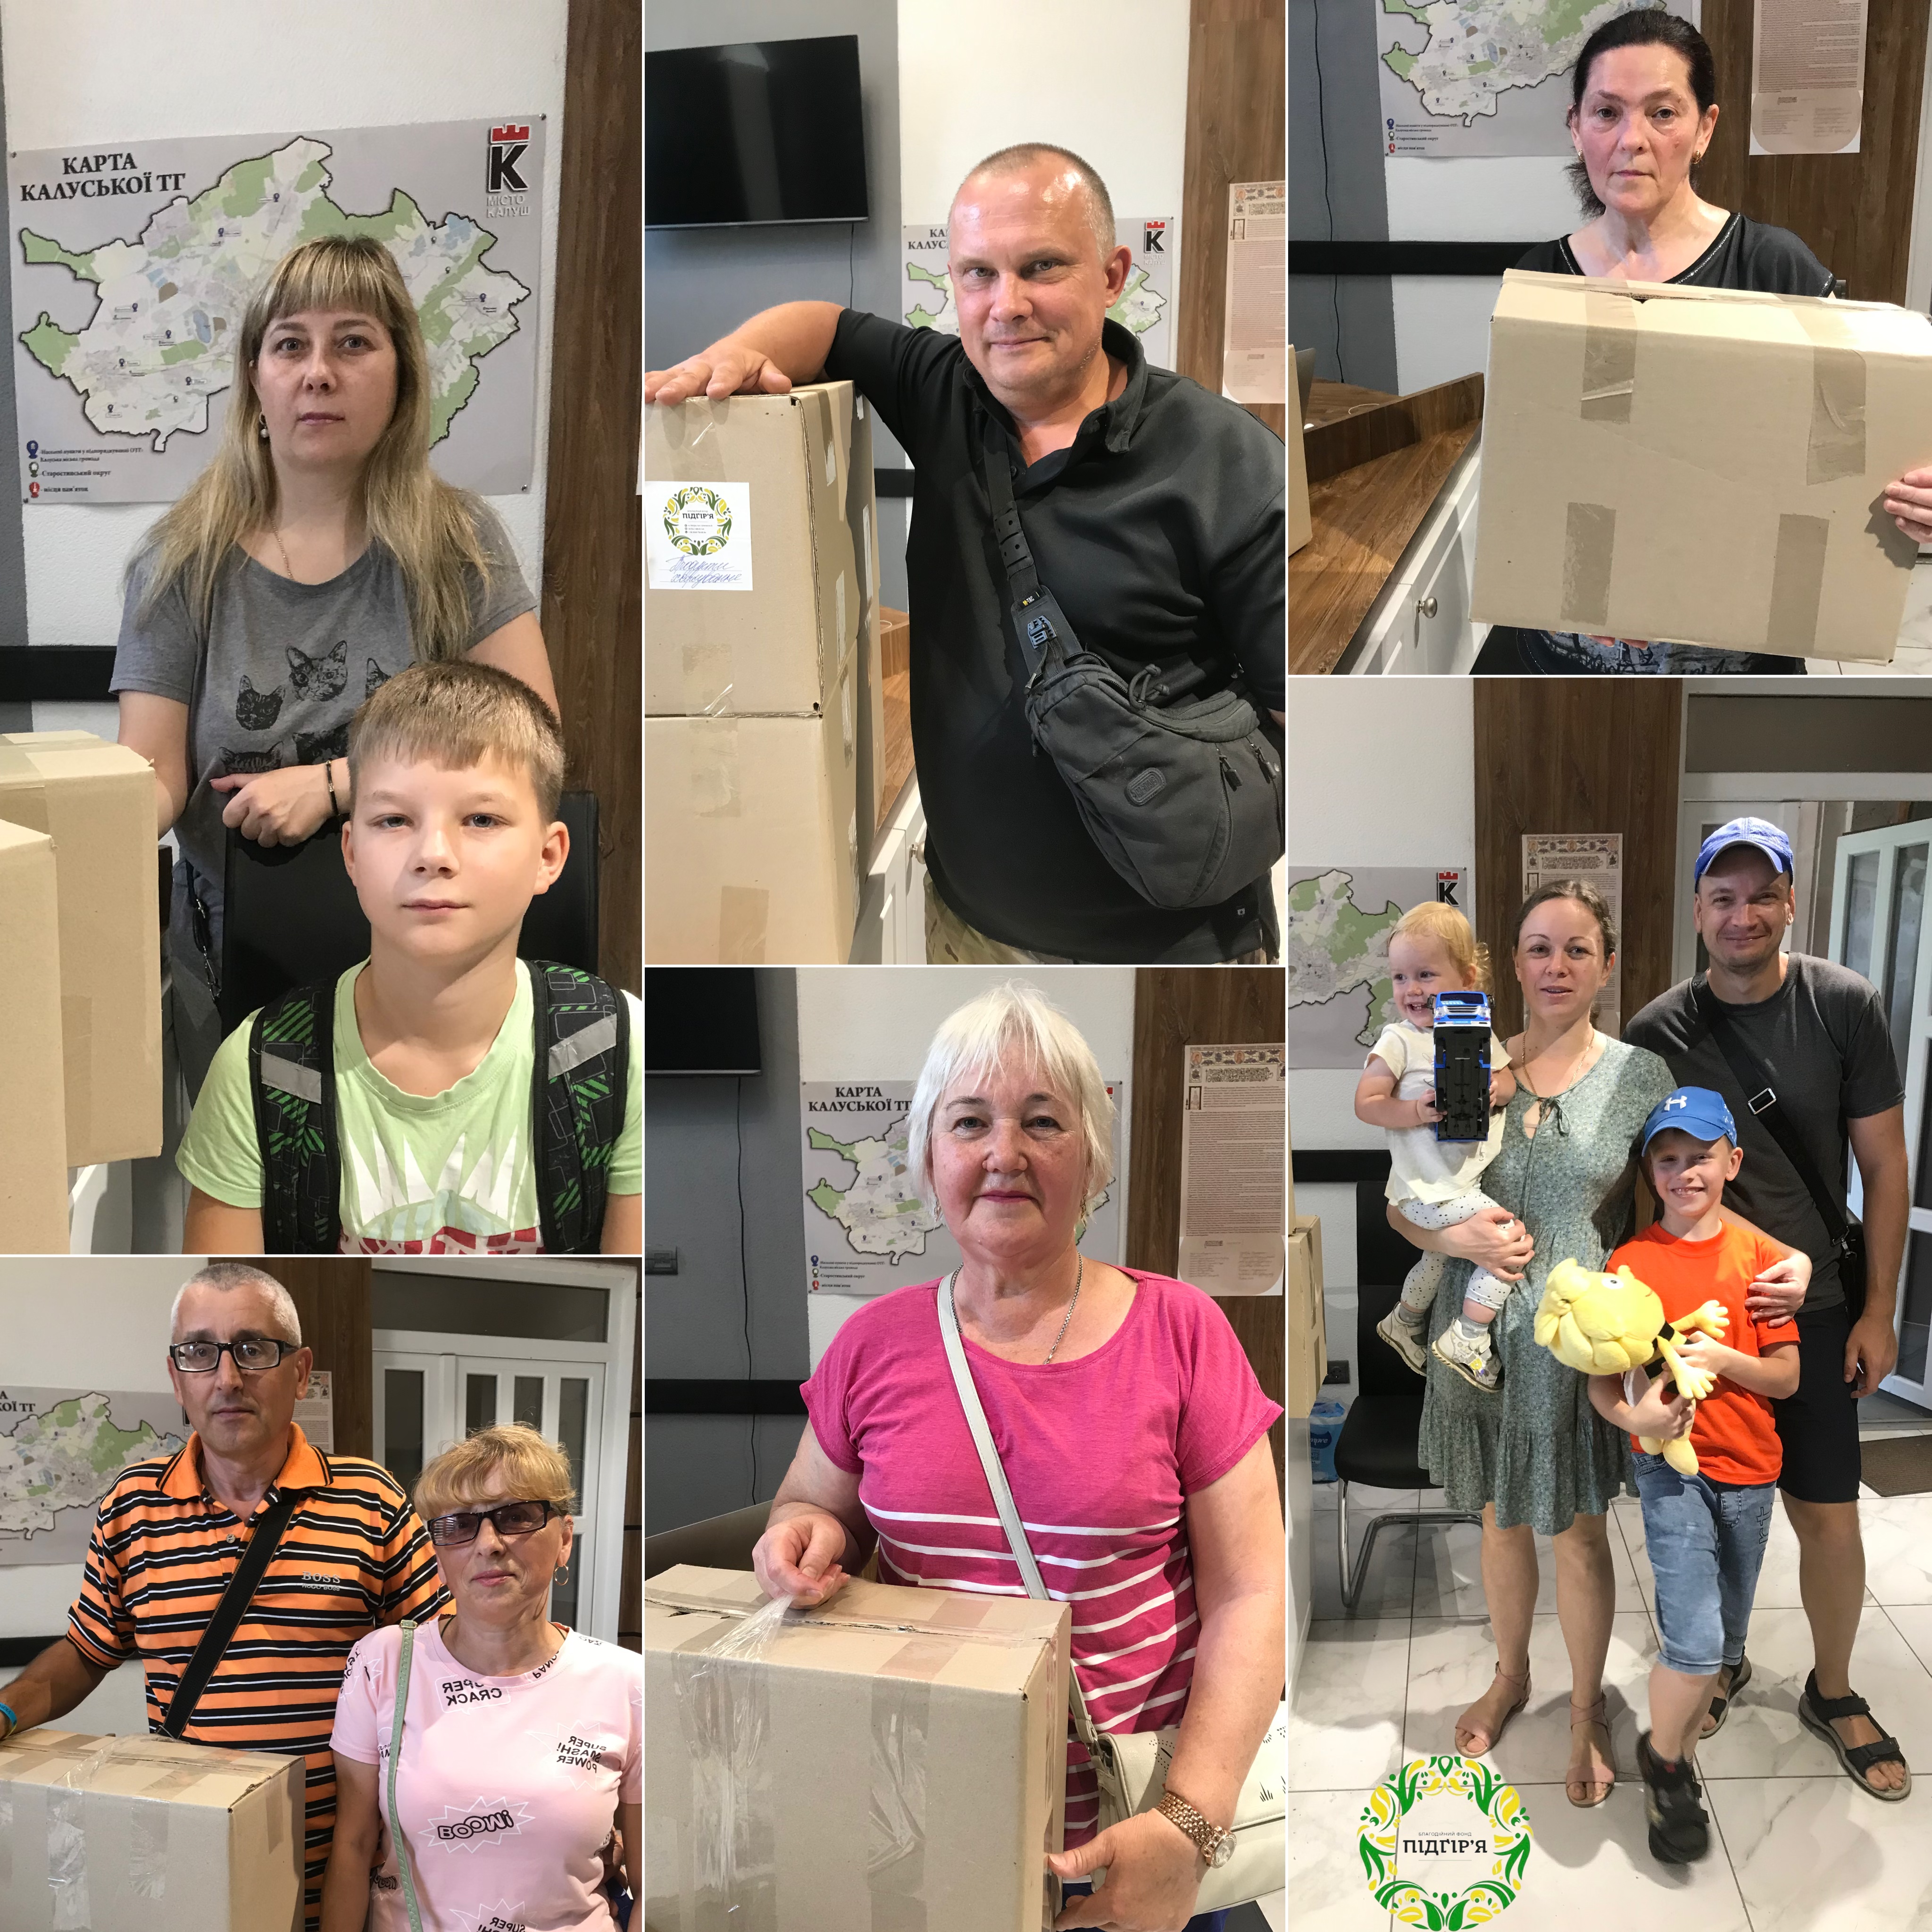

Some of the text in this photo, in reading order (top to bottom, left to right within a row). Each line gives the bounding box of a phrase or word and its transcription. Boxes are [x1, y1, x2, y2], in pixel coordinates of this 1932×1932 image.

[62, 152, 138, 175] КАРТА
[20, 171, 186, 201] КАЛУСЬКОЇ ТГ
[486, 195, 524, 207] МІСТО
[486, 206, 529, 218] КАЛУШ
[908, 240, 948, 250] КАЛУС
[1023, 596, 1034, 606] M-TAC
[835, 1086, 882, 1098] КАРТА
[808, 1098, 892, 1112] КАЛУСЬКОЇ
[19, 1403, 36, 1412] ТГ
[301, 1571, 341, 1583] BOSS
